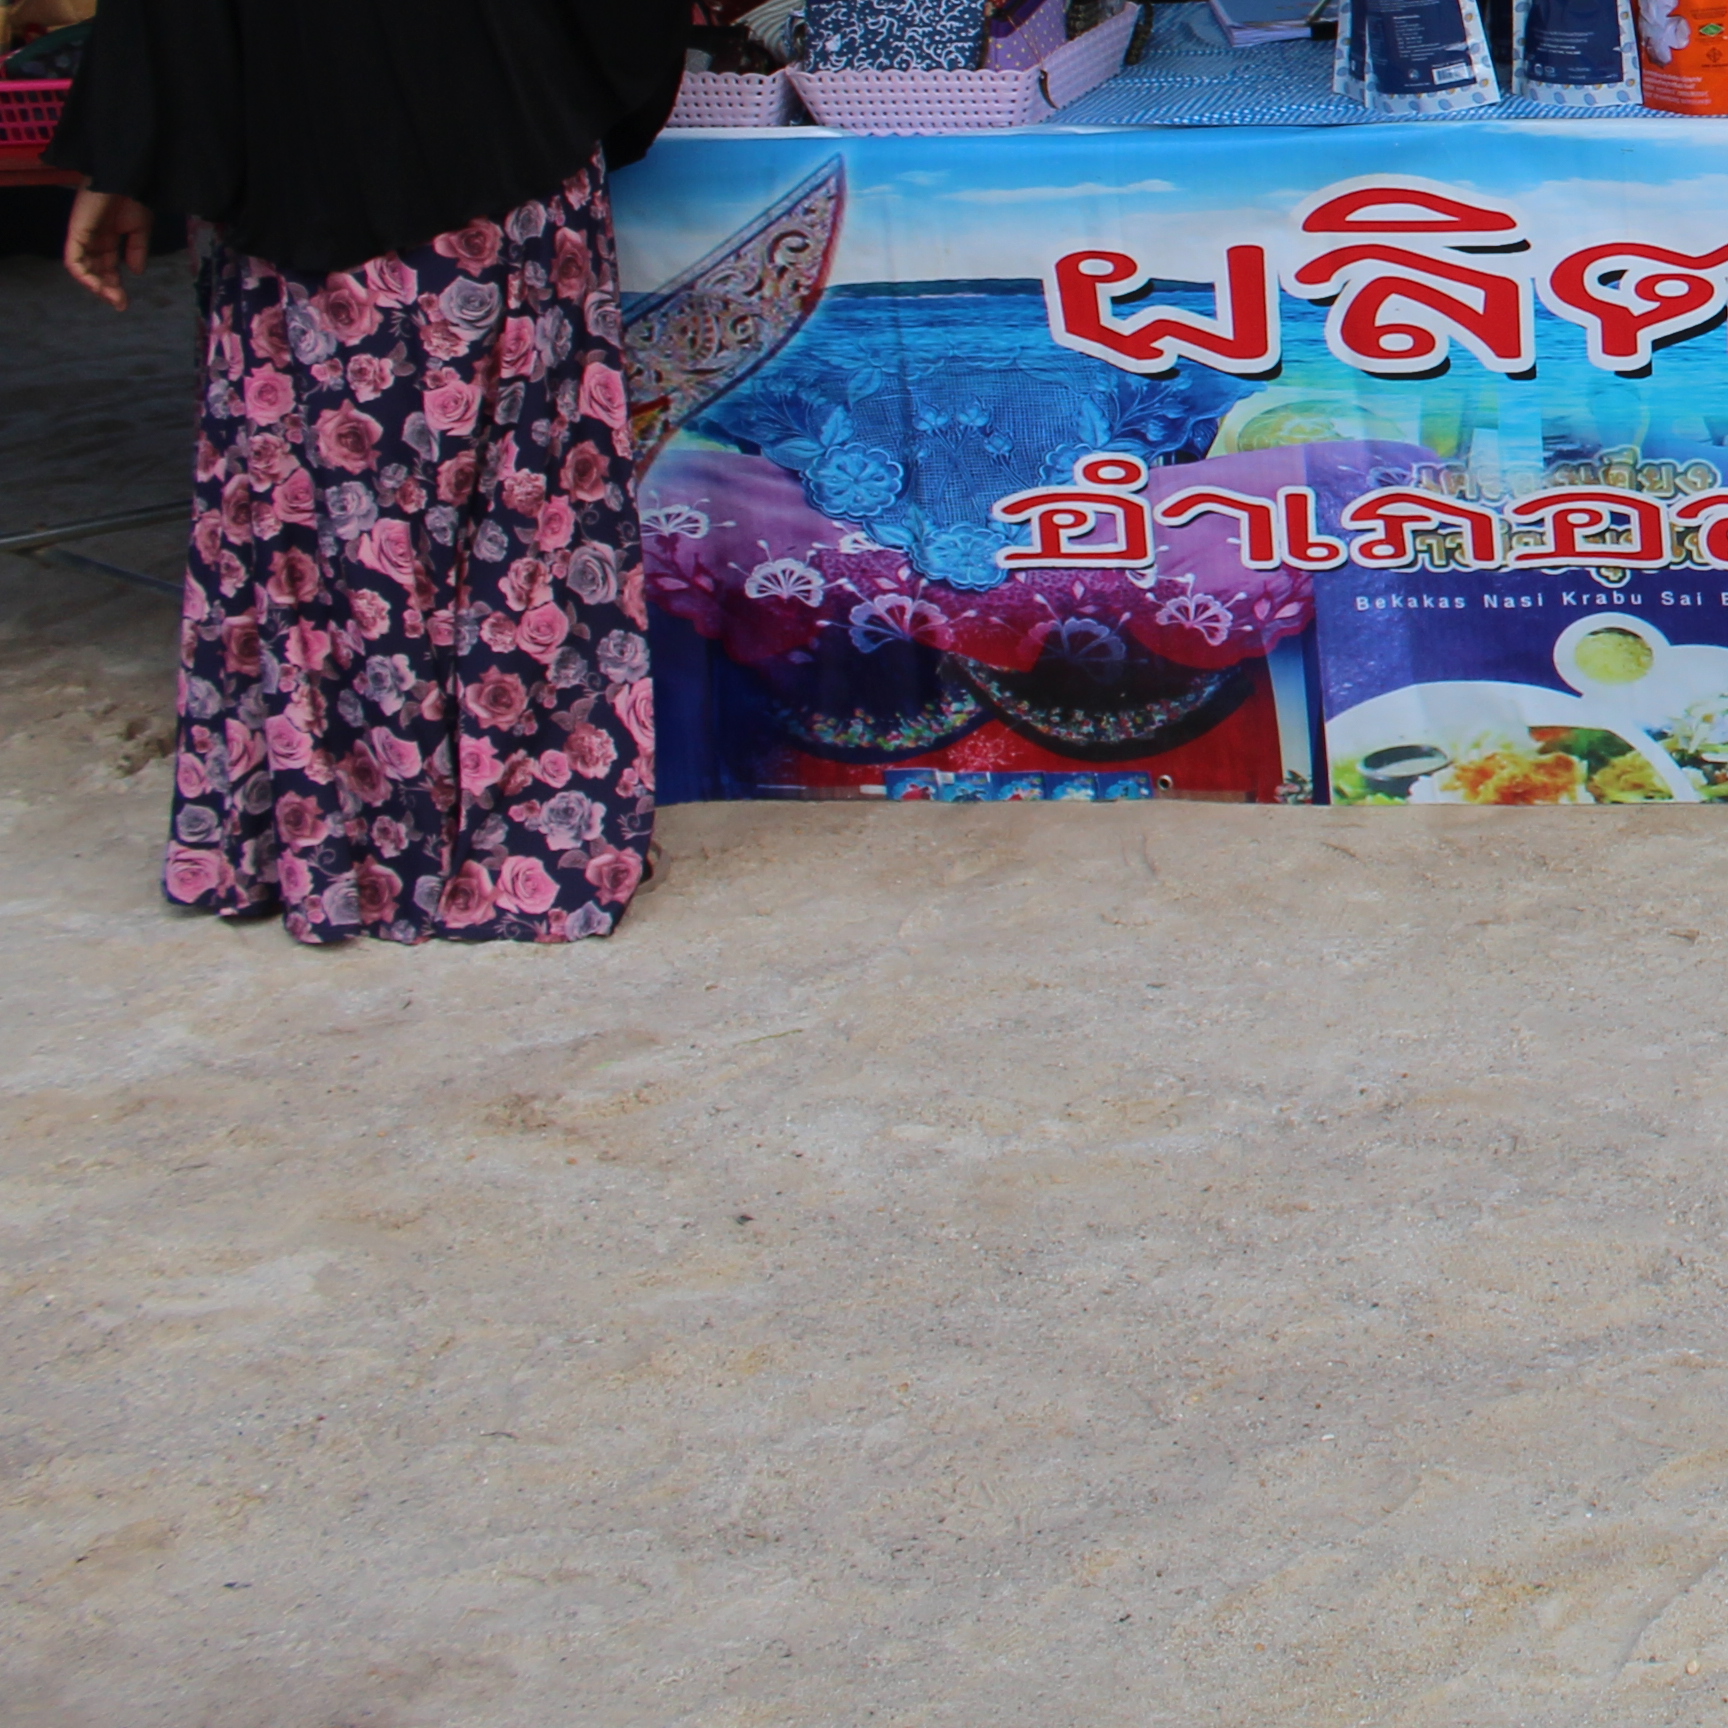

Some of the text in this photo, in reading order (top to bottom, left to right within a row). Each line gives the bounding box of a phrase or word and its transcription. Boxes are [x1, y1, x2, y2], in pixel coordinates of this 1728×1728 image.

[1356, 593, 1466, 611] Bekakas
[1483, 591, 1544, 608] Nasi
[1561, 589, 1643, 606] Krabu
[1661, 590, 1702, 606] Sai
